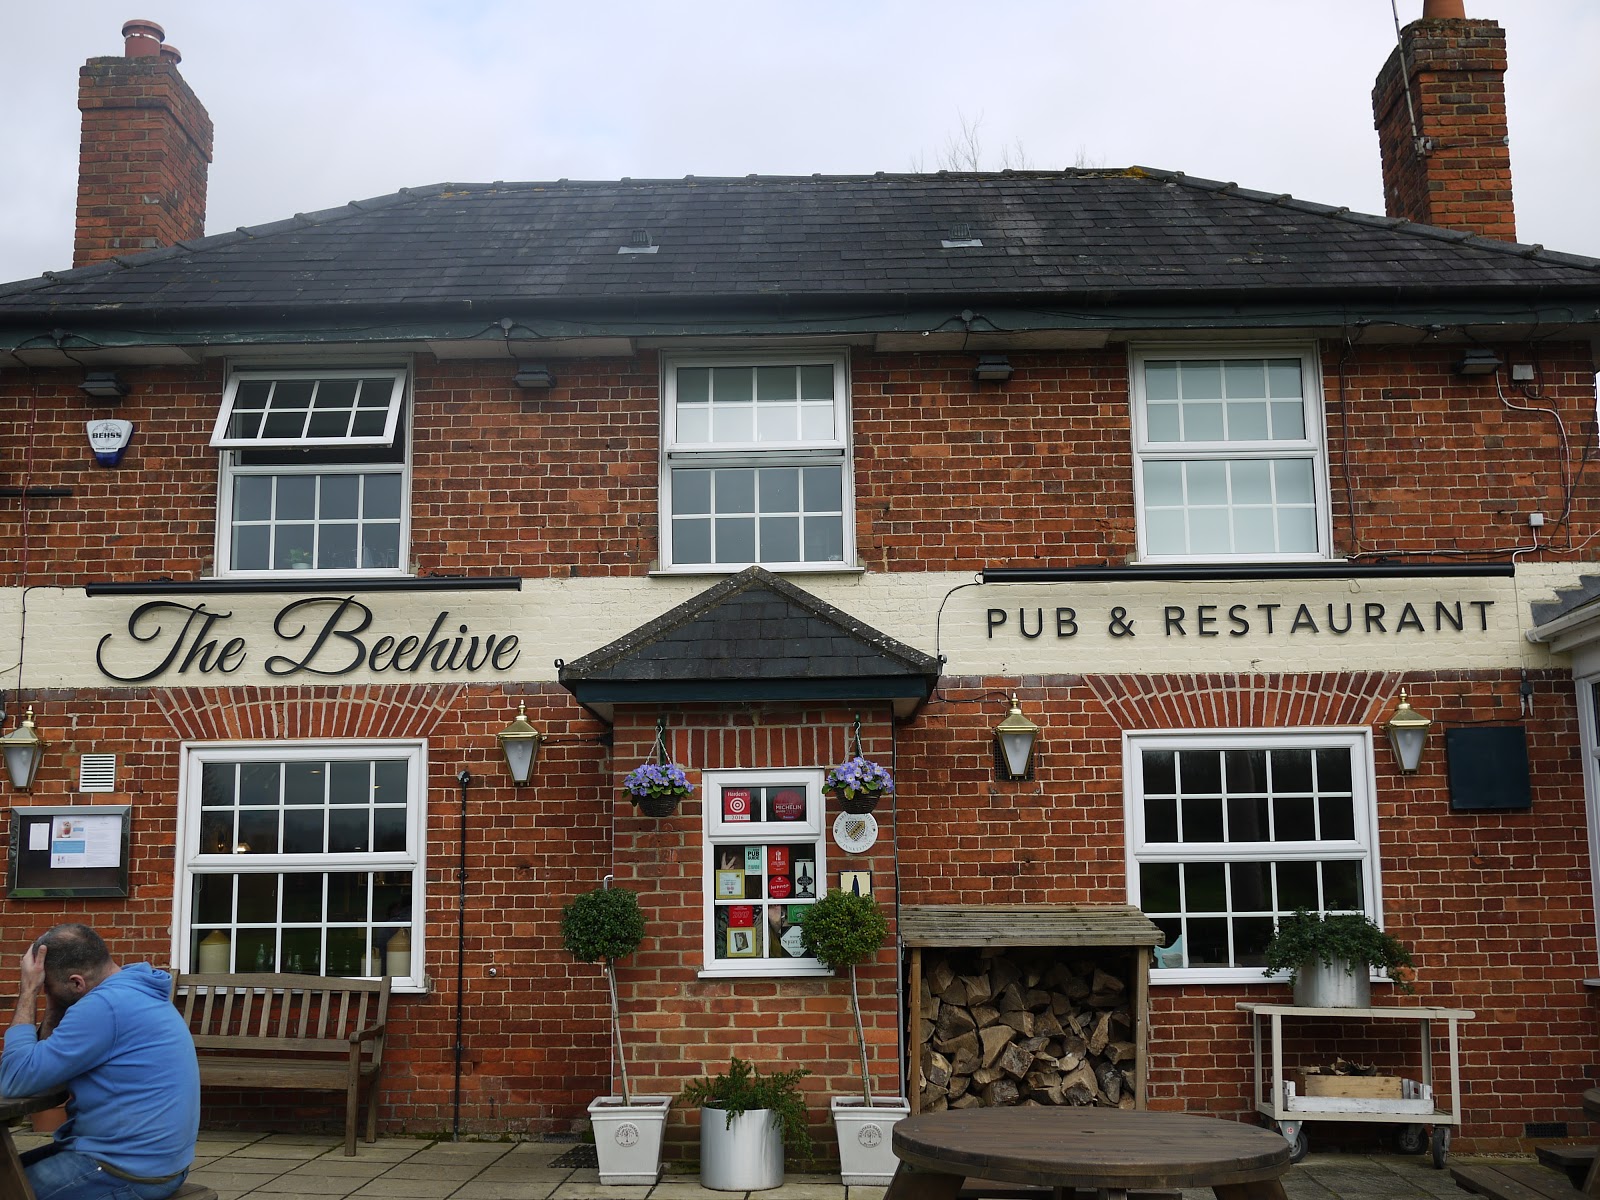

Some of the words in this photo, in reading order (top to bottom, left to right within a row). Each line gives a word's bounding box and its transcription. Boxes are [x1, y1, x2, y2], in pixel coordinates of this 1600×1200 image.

[96, 600, 247, 684] The
[264, 595, 521, 676] Beehive
[987, 607, 1079, 639] PUB
[1108, 606, 1136, 639] &
[1164, 600, 1496, 638] RESTAURANT
